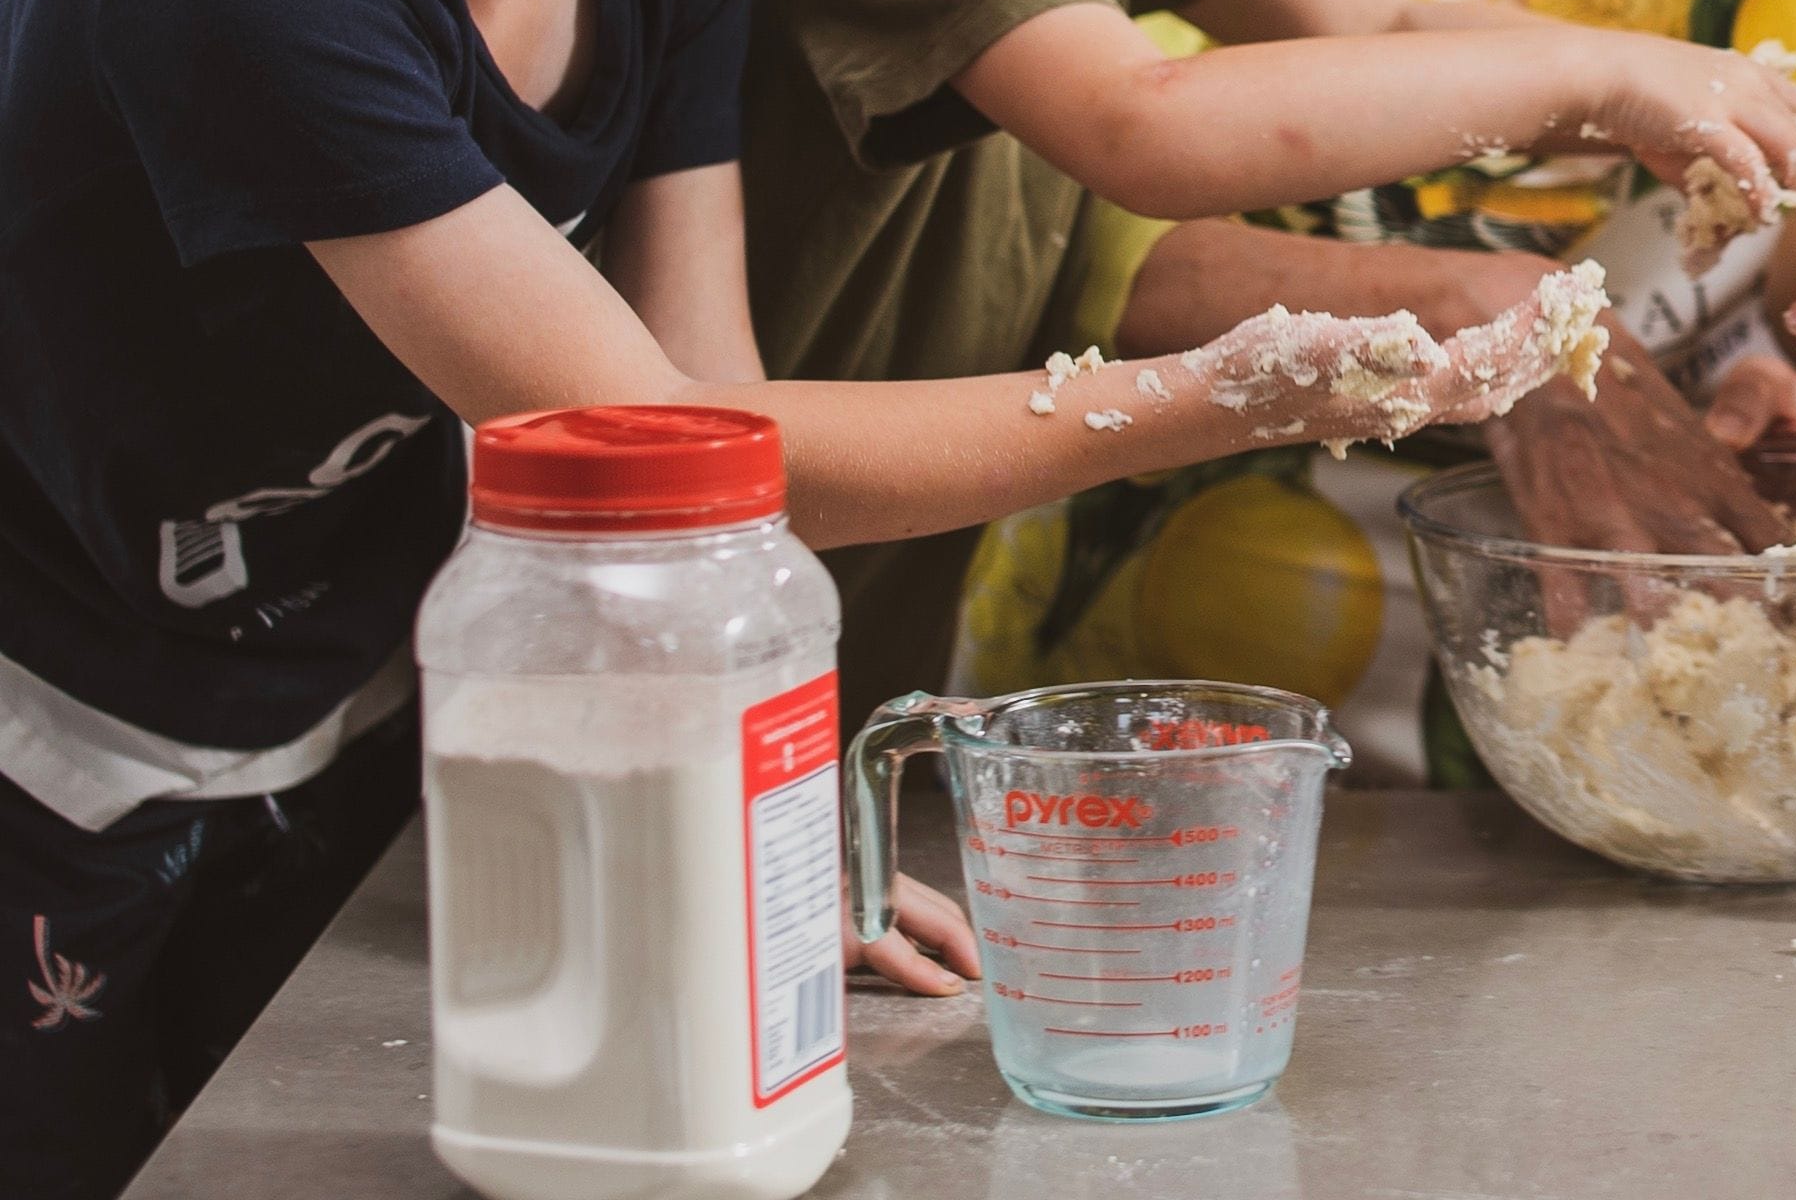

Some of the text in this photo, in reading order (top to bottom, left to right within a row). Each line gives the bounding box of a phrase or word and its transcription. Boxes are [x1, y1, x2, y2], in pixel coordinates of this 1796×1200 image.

[1004, 789, 1143, 829] pyrex
[1184, 827, 1218, 844] 500
[1183, 871, 1217, 887] 400
[1183, 916, 1216, 932] 300
[1183, 968, 1214, 983] 200
[1183, 1023, 1211, 1038] 100
